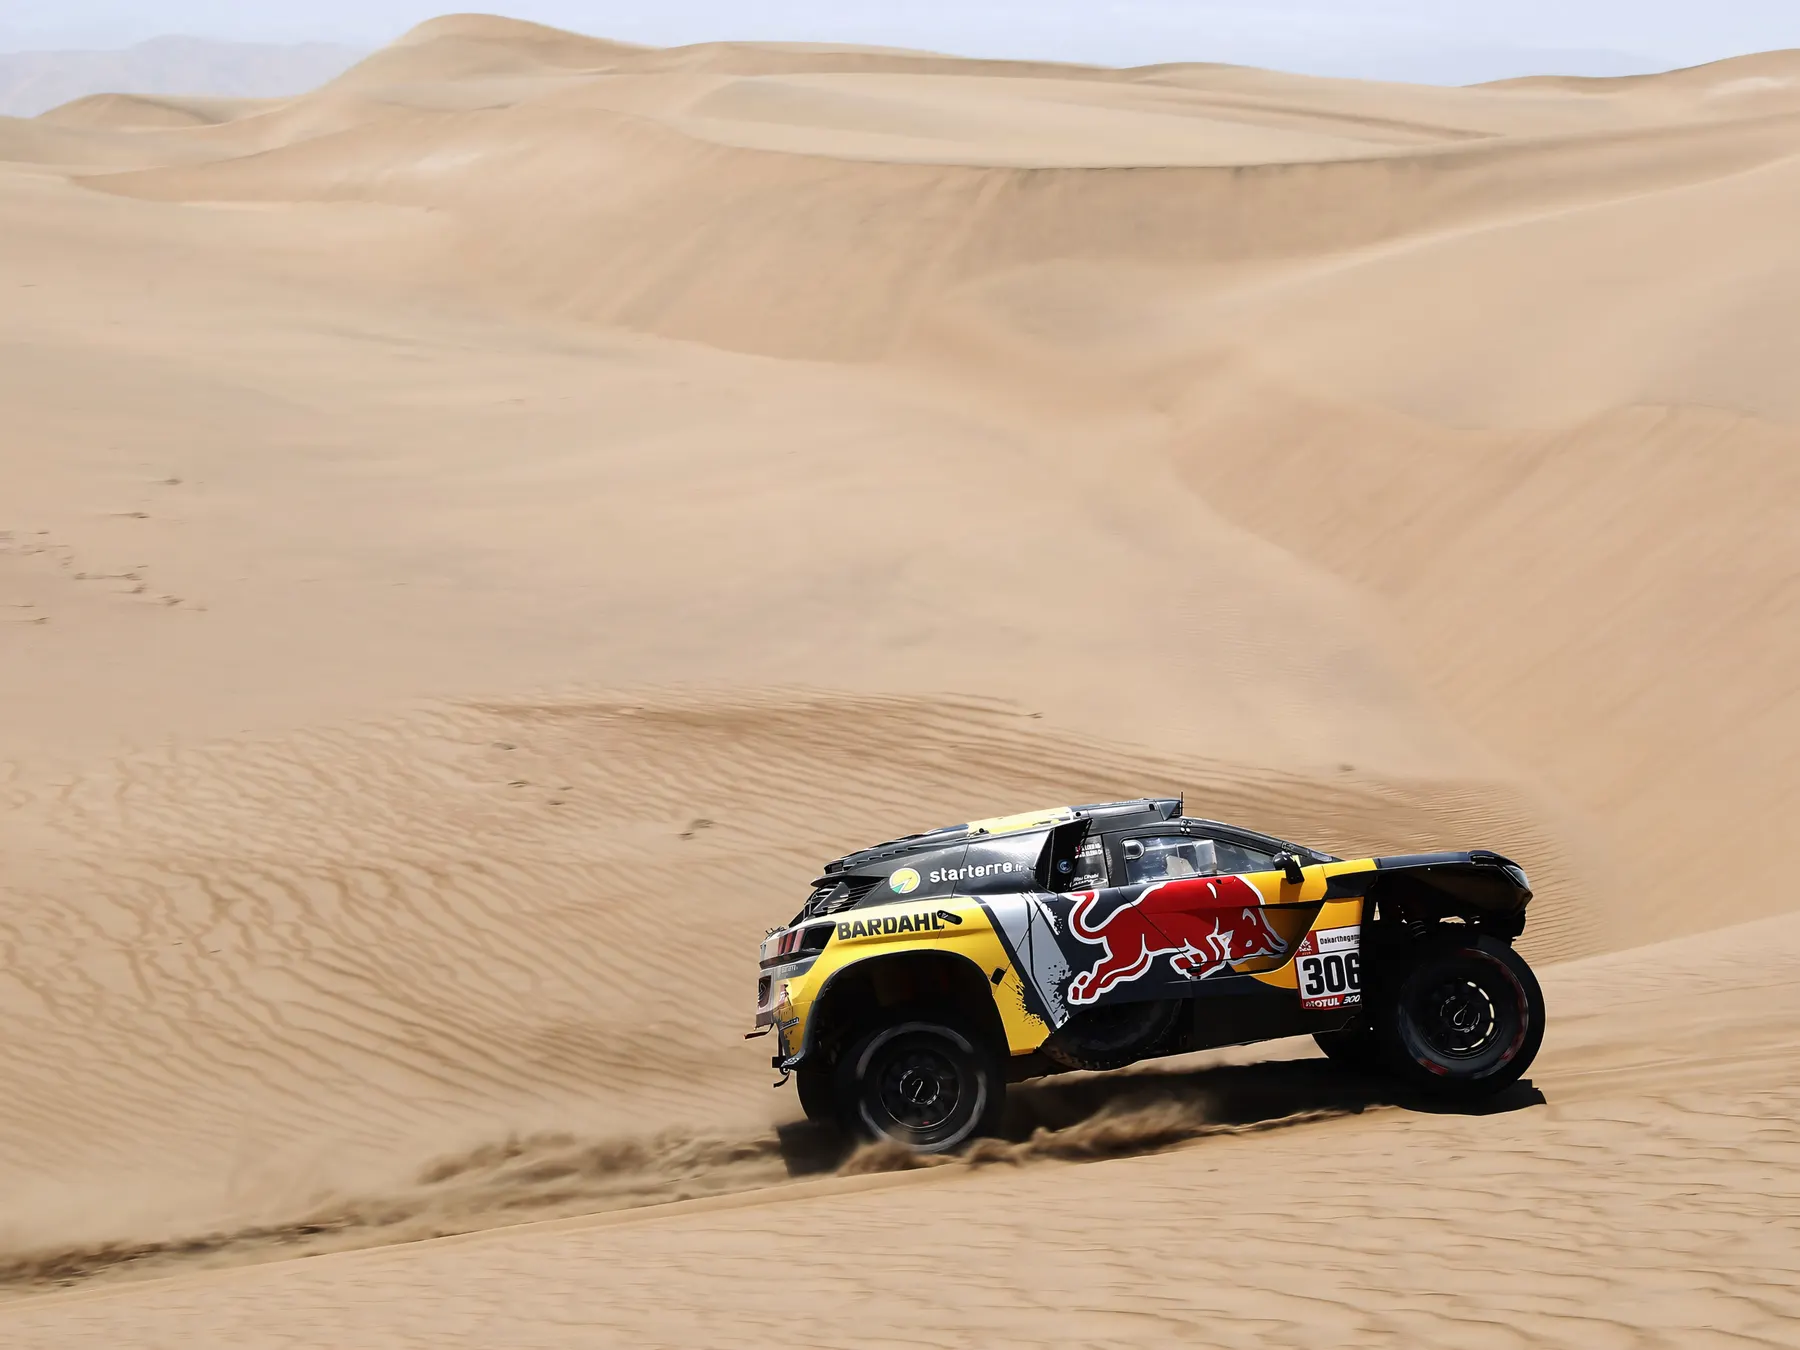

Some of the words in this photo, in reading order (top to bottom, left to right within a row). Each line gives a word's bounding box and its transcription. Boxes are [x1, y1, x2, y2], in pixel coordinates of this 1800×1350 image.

[930, 862, 1023, 883] starterre.fr
[837, 912, 945, 940] BARDAHL
[1303, 953, 1360, 996] 306
[1305, 998, 1340, 1007] MOTUL
